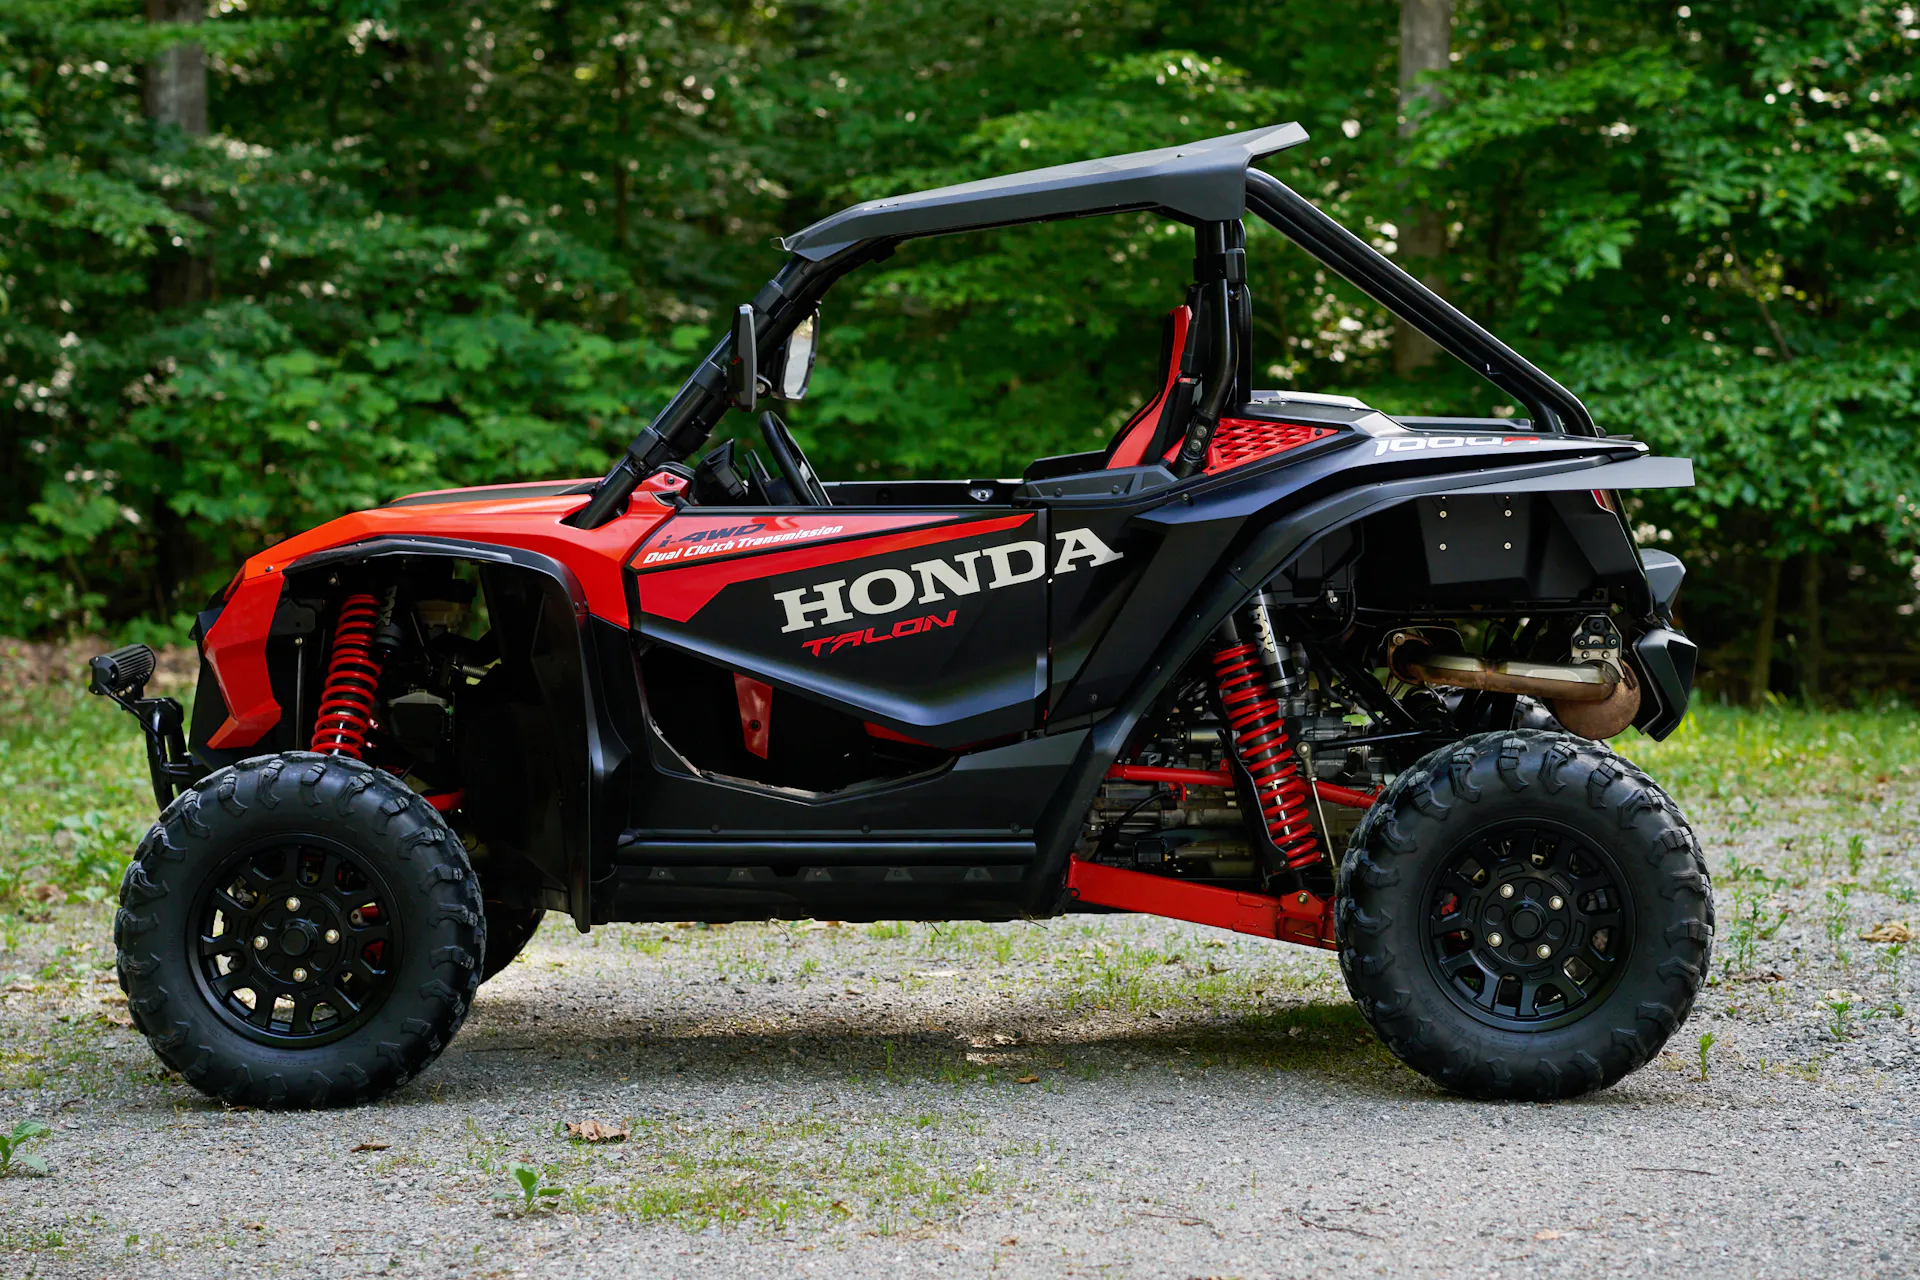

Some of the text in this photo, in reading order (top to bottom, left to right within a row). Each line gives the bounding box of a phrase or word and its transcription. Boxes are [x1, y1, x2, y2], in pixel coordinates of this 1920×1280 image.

[643, 525, 844, 564] Dual Clutch Transmission
[657, 523, 766, 548] i-4WD
[773, 527, 1124, 634] HONDA
[801, 609, 958, 657] TALON
[1247, 604, 1276, 656] FOX
